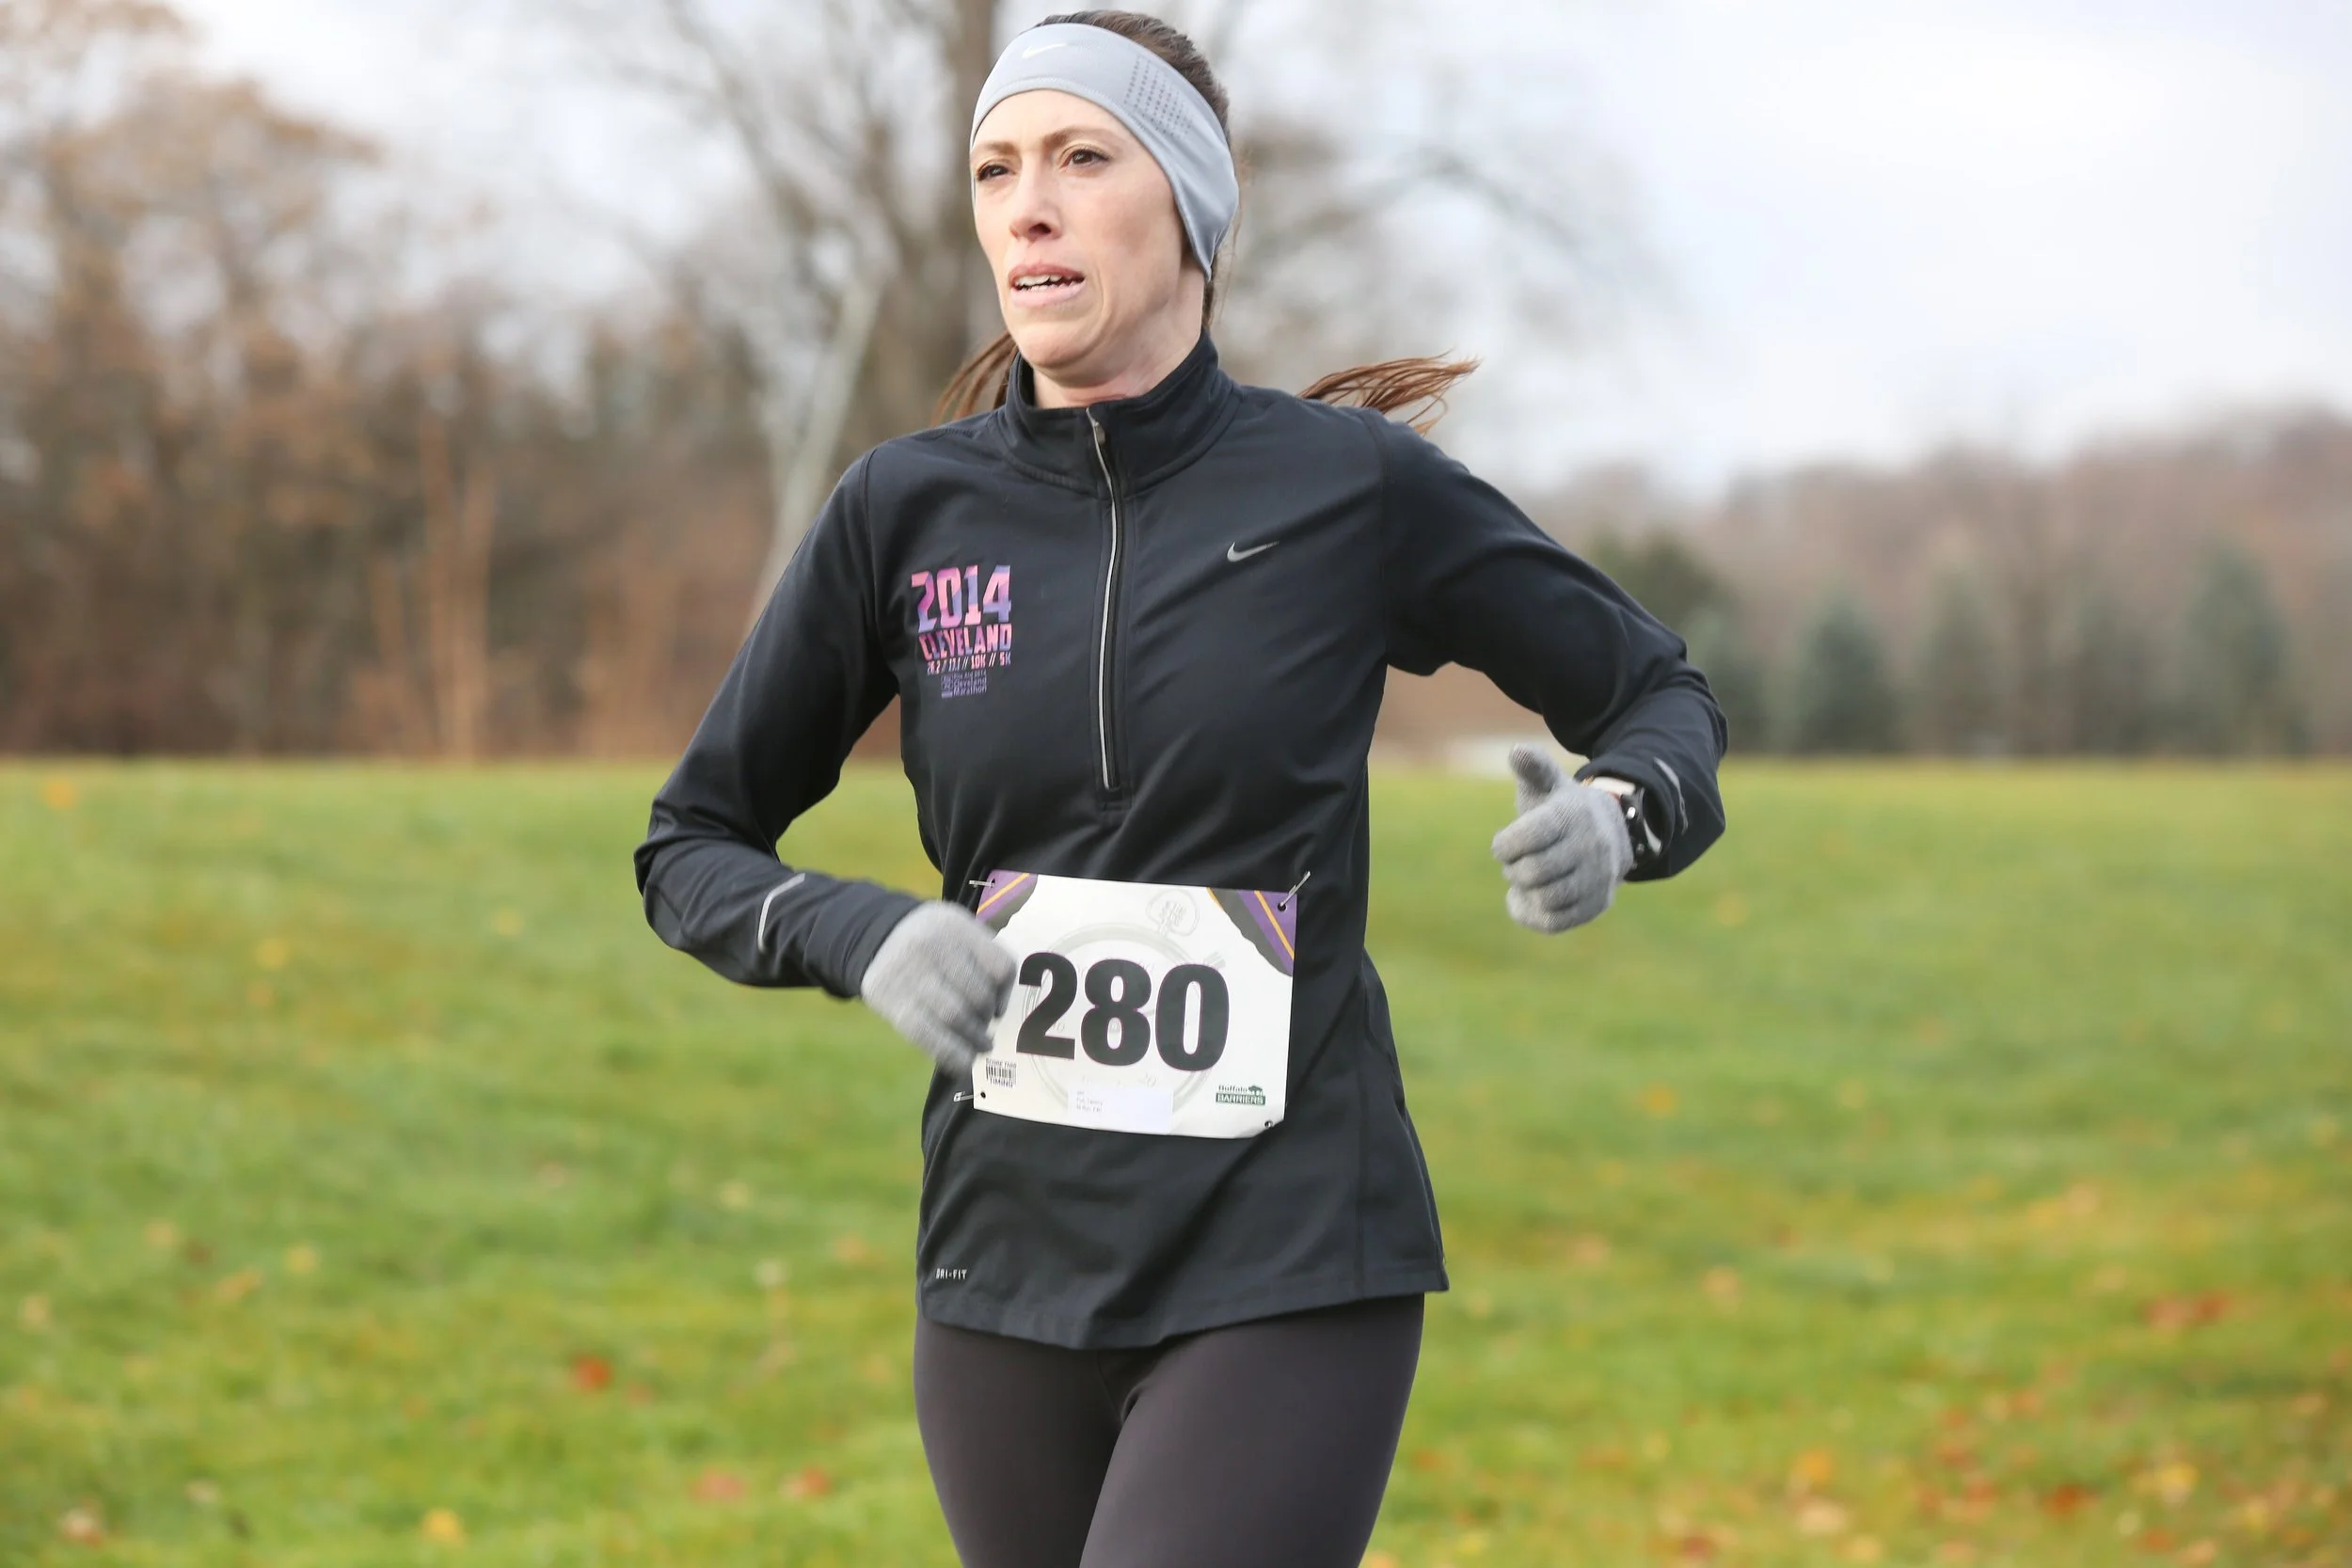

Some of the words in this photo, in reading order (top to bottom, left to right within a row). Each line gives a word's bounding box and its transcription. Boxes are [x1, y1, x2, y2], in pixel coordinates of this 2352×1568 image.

[911, 564, 1012, 632] 2014
[918, 624, 1012, 660] CLEVELAND
[971, 654, 986, 669] 10K
[1016, 951, 1230, 1072] 280
[1218, 1085, 1248, 1093] Buffalo
[935, 1267, 967, 1280] DRI-FIT
